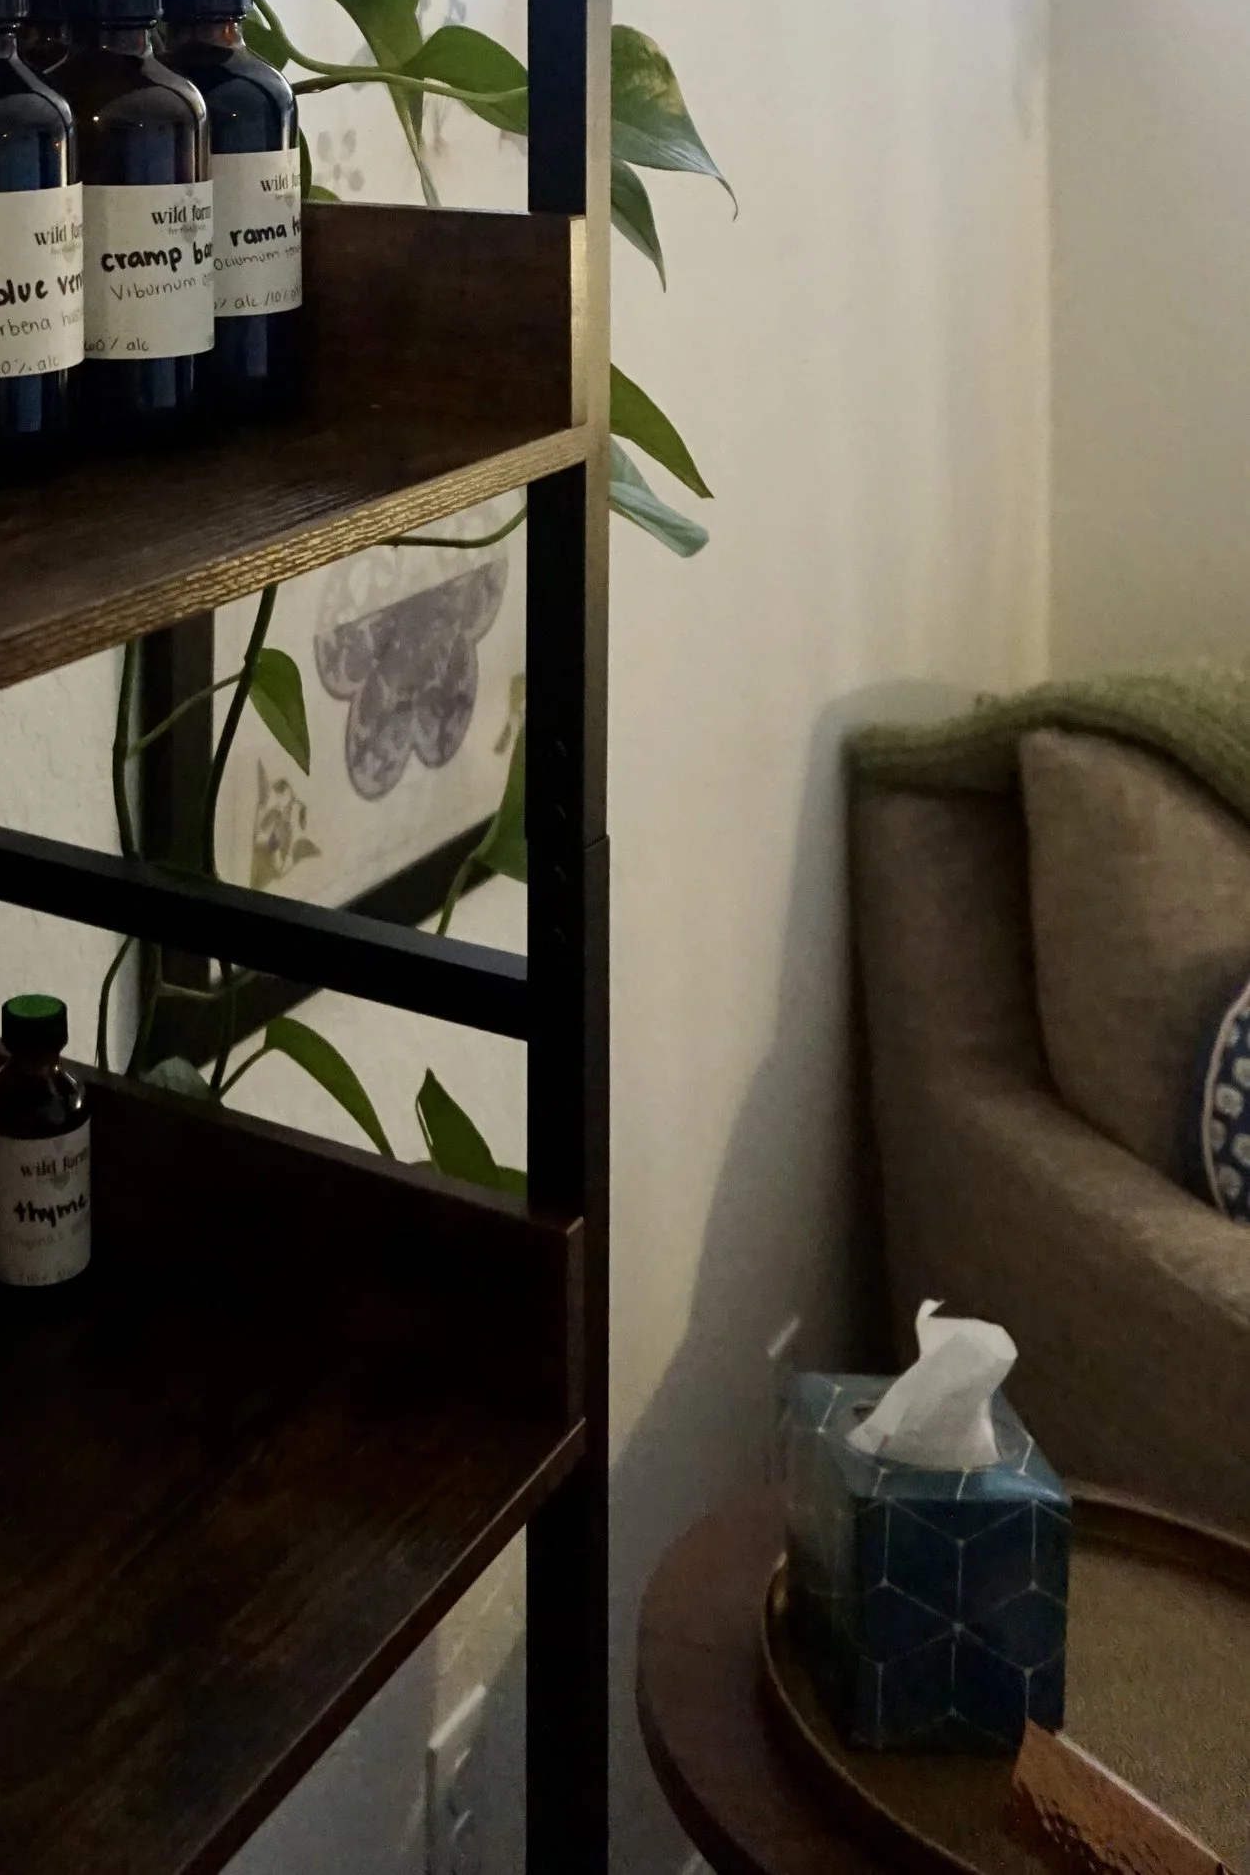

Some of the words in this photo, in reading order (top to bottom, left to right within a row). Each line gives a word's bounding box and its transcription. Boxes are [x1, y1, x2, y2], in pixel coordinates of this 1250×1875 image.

[260, 174, 289, 192] wild
[151, 204, 187, 225] wild
[33, 224, 67, 246] wild
[229, 223, 287, 247] rama
[101, 246, 183, 273] cramp
[109, 277, 197, 301] Viburnum
[126, 337, 149, 352] alc
[12, 1192, 88, 1229] thyme
